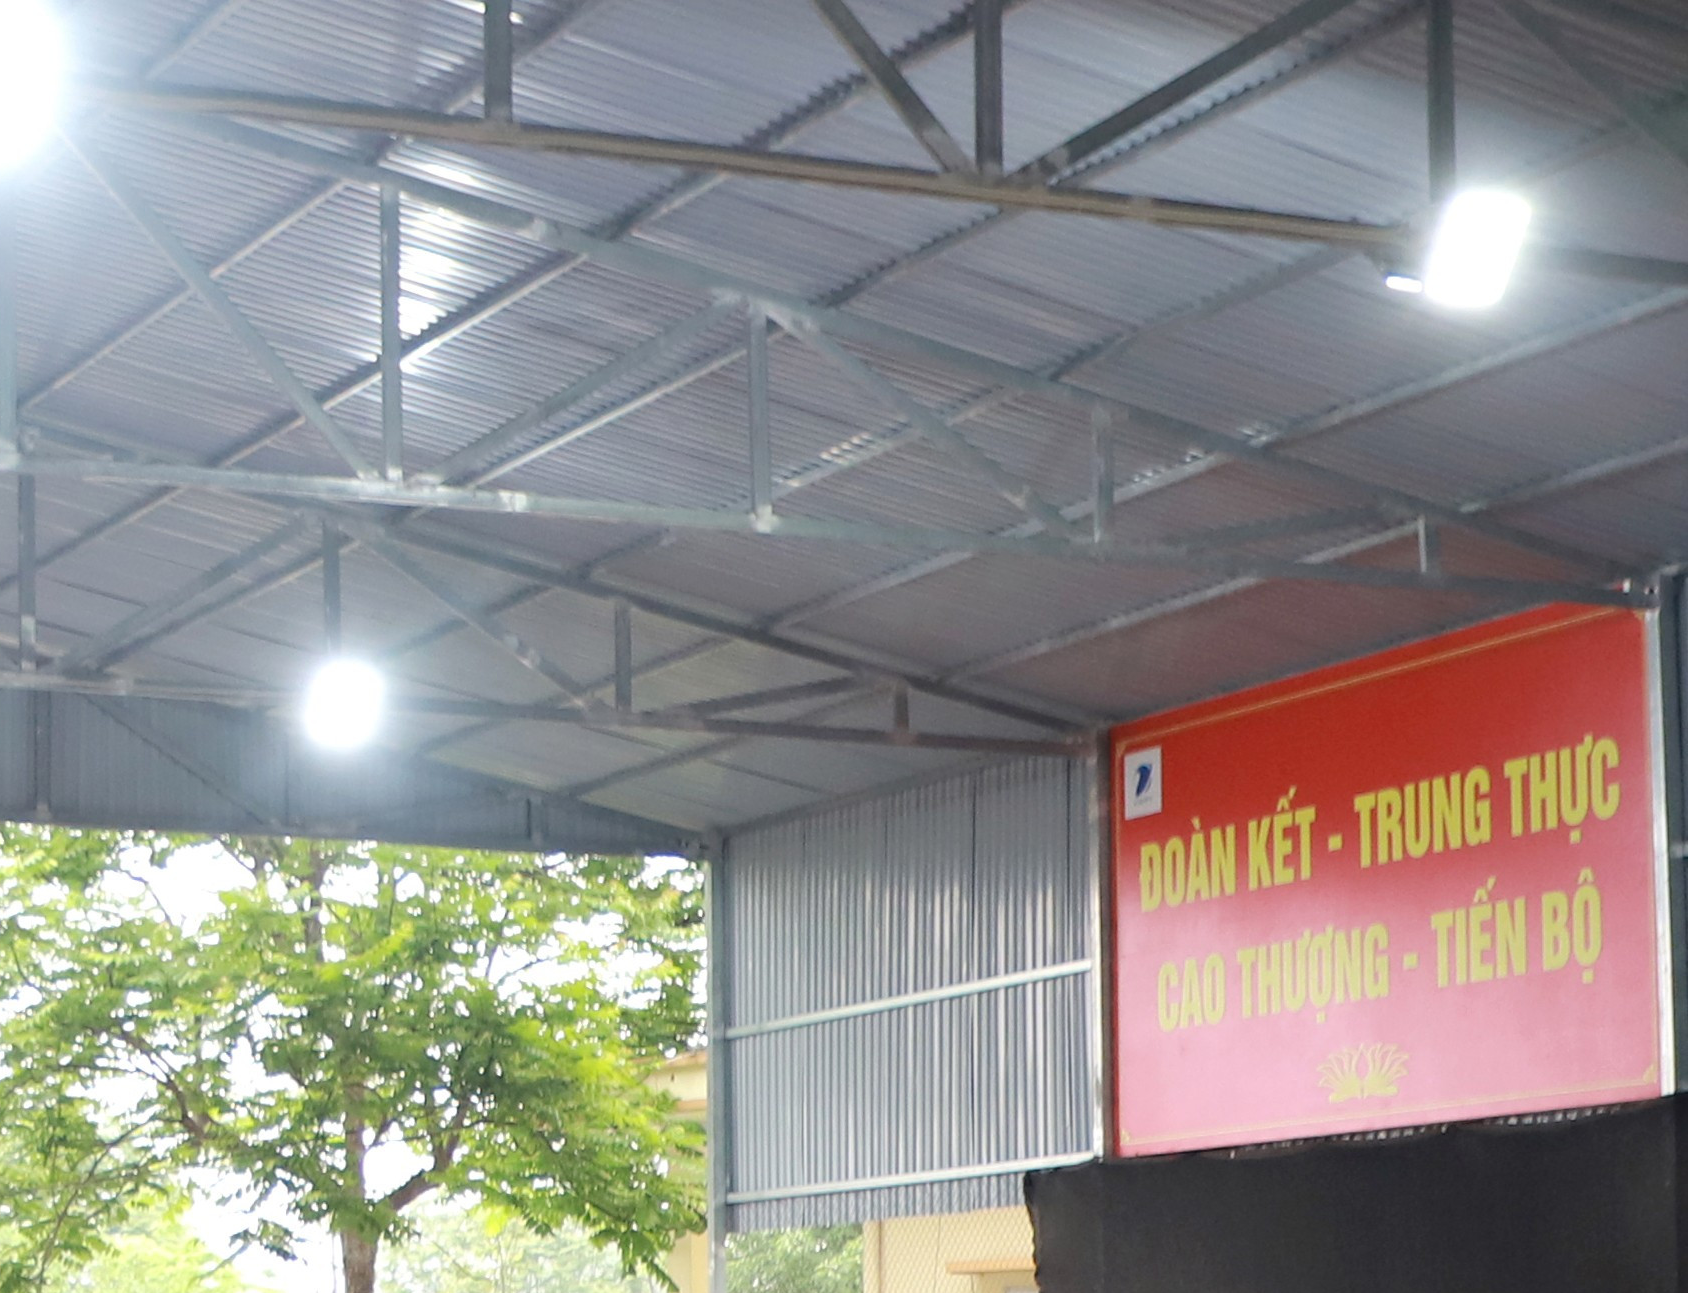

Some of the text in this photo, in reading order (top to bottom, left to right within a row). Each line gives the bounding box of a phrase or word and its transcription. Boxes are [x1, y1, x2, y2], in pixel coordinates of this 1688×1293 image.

[1139, 734, 1620, 911] ĐOÀN KẾT - TRUNG THỰC
[1157, 868, 1603, 1033] CAO THƯỢNG - TIẾN BỘ
